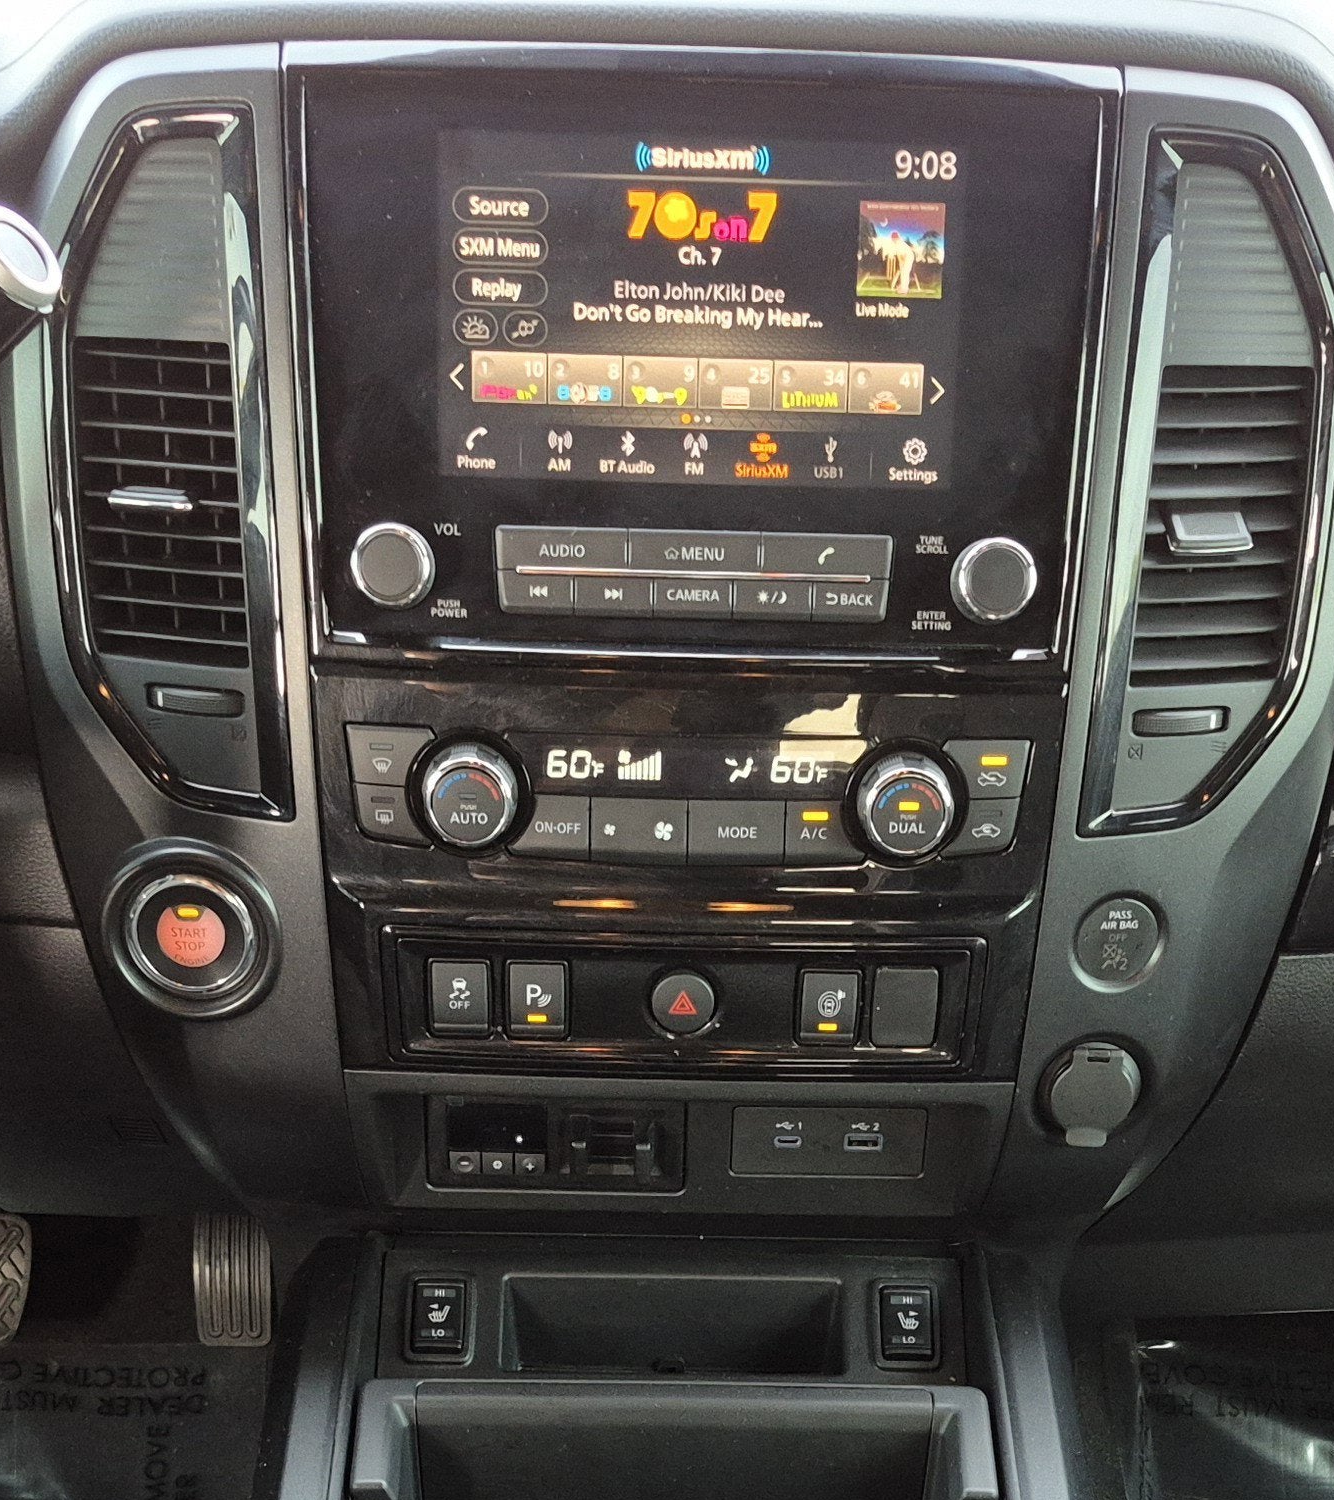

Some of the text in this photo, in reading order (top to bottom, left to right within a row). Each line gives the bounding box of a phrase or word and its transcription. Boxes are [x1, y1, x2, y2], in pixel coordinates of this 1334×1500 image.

[895, 149, 957, 180] 9:08
[468, 195, 530, 217] Source
[459, 236, 540, 258] SXM Menu
[678, 246, 722, 266] Ch. 7
[471, 277, 522, 302] Replay
[613, 279, 785, 304] Elton John/Kiki Dee
[573, 301, 623, 322] Don't
[625, 303, 651, 323] Go
[655, 304, 733, 328] Breaking
[735, 307, 764, 331] My
[855, 302, 909, 319] Live Mode
[481, 360, 544, 377] 1 10
[555, 362, 619, 380] 2 8
[631, 364, 695, 382] 3 9
[706, 367, 770, 385] 4 25
[823, 368, 845, 387] 34
[856, 370, 919, 389] 6 41
[456, 454, 938, 485] Phone AM BT Audio FM SiriusXM USB1 Settings
[433, 522, 462, 537] VOL
[919, 535, 944, 546] TUNE
[538, 544, 586, 558] AUDIO
[681, 547, 725, 561] MENU
[915, 543, 949, 555] SCROLL
[666, 589, 720, 602] CAMERA
[840, 593, 873, 606] BACK
[437, 599, 461, 609] PUSH
[430, 607, 468, 619] POWER
[916, 610, 946, 621] ENTER
[911, 620, 952, 631] SETTING
[449, 811, 489, 826] AUTO
[717, 826, 758, 839] MODE
[800, 826, 828, 840] A/C
[888, 821, 927, 834] DUAL
[1108, 909, 1133, 920] PASS
[1100, 919, 1139, 930] AIR BAG
[170, 927, 208, 938] START
[174, 940, 206, 951] STOP
[449, 999, 471, 1010] OFF
[431, 1329, 445, 1337] LO
[902, 1336, 915, 1344] LO
[33, 1361, 209, 1389] PROTECTIVE
[0, 1388, 78, 1415] MUST
[96, 1392, 207, 1419] DEALER
